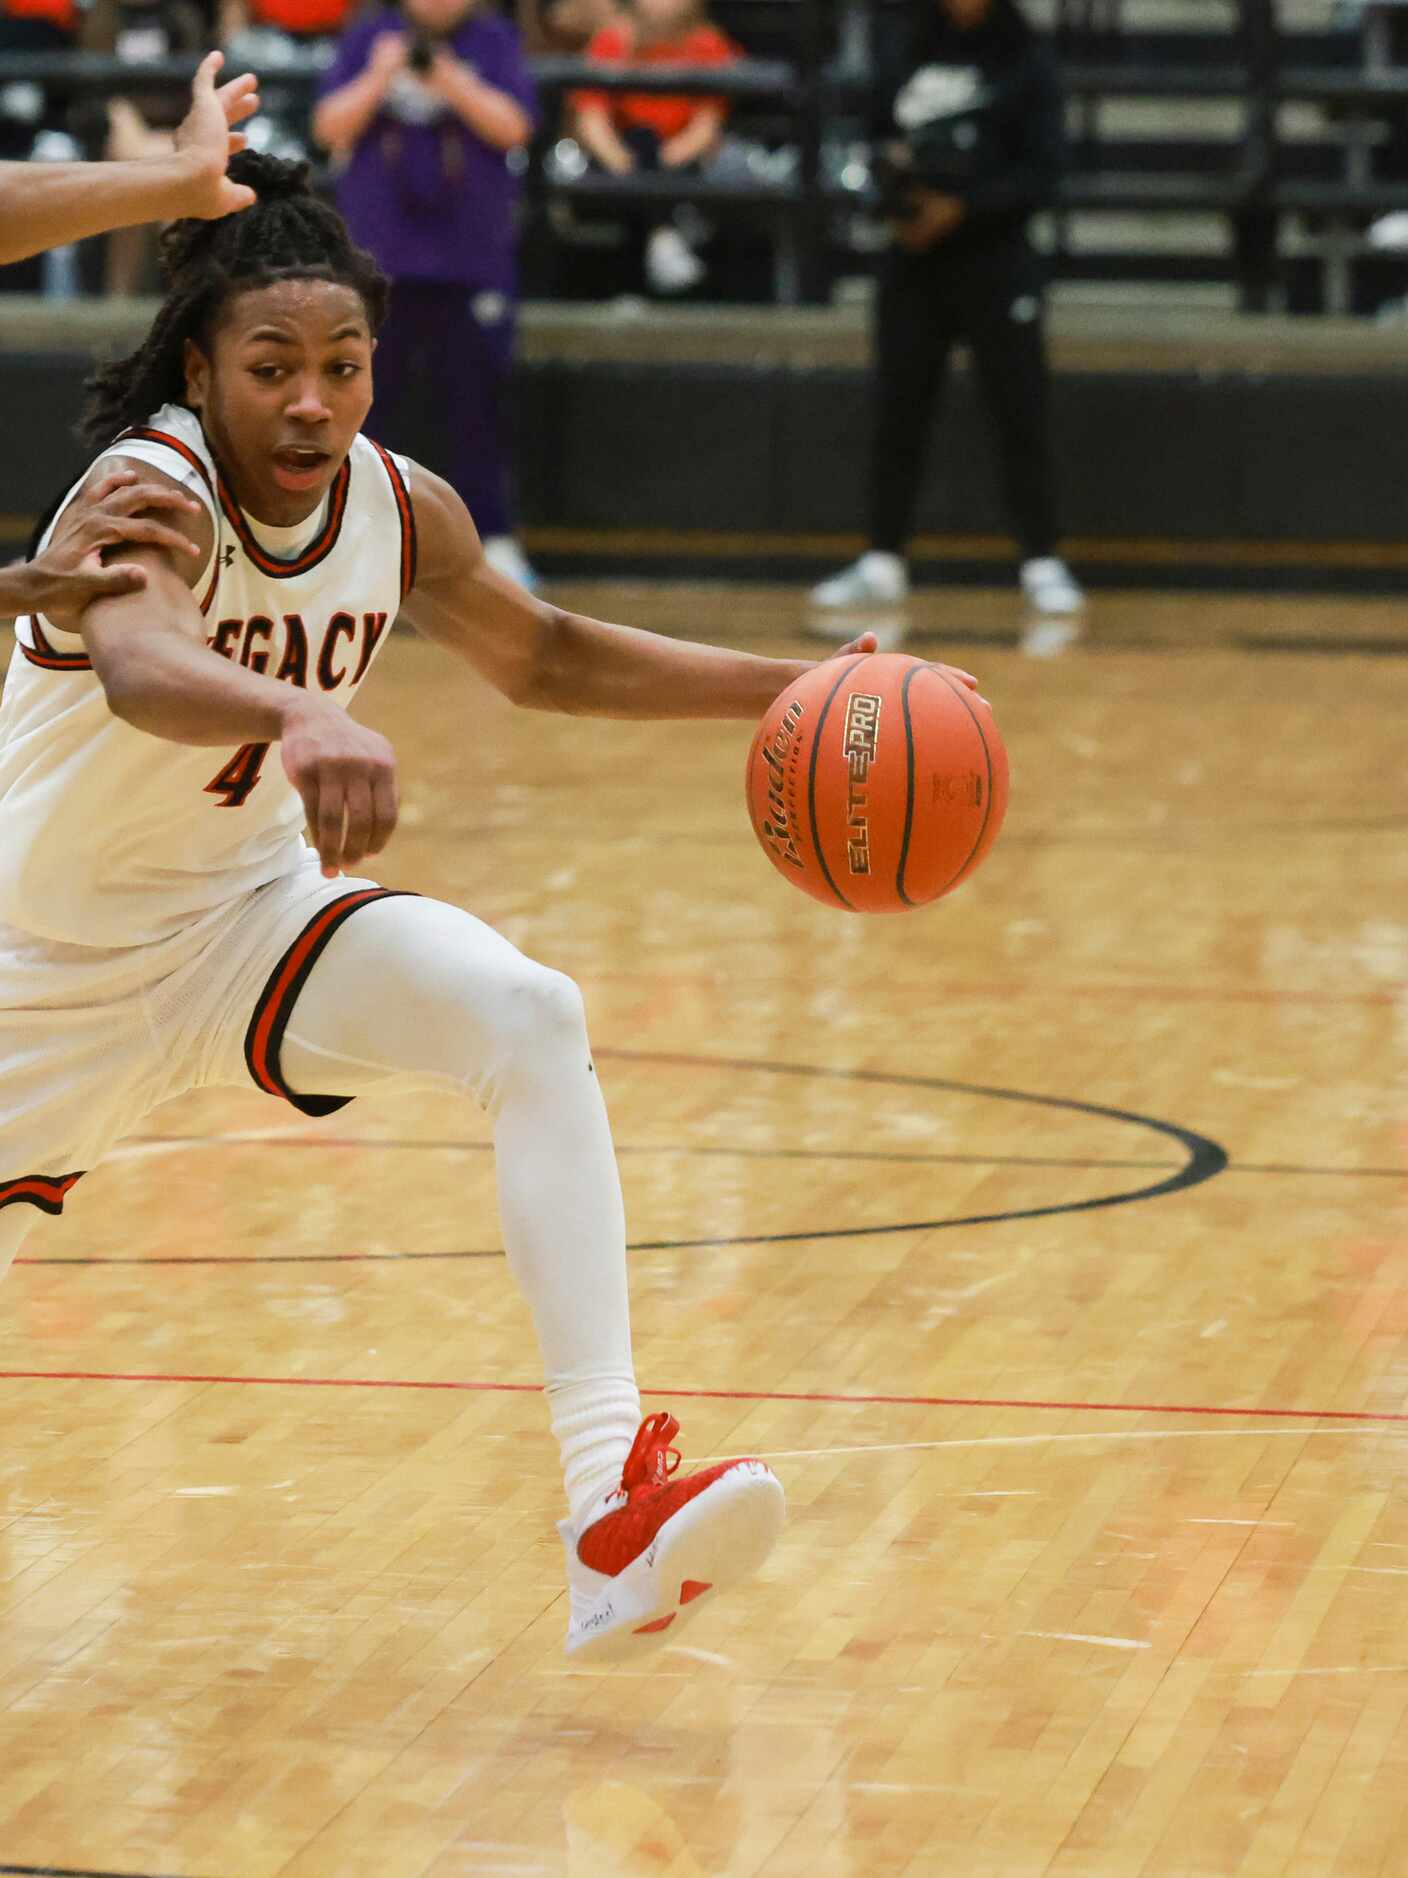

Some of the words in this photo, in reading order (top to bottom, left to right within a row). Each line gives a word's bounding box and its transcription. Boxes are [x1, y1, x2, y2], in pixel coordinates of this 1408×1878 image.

[206, 611, 388, 692] EGACY
[850, 696, 877, 748] PRO
[203, 742, 271, 807] 4
[760, 699, 805, 869] Baden
[846, 751, 872, 876] ELITE
